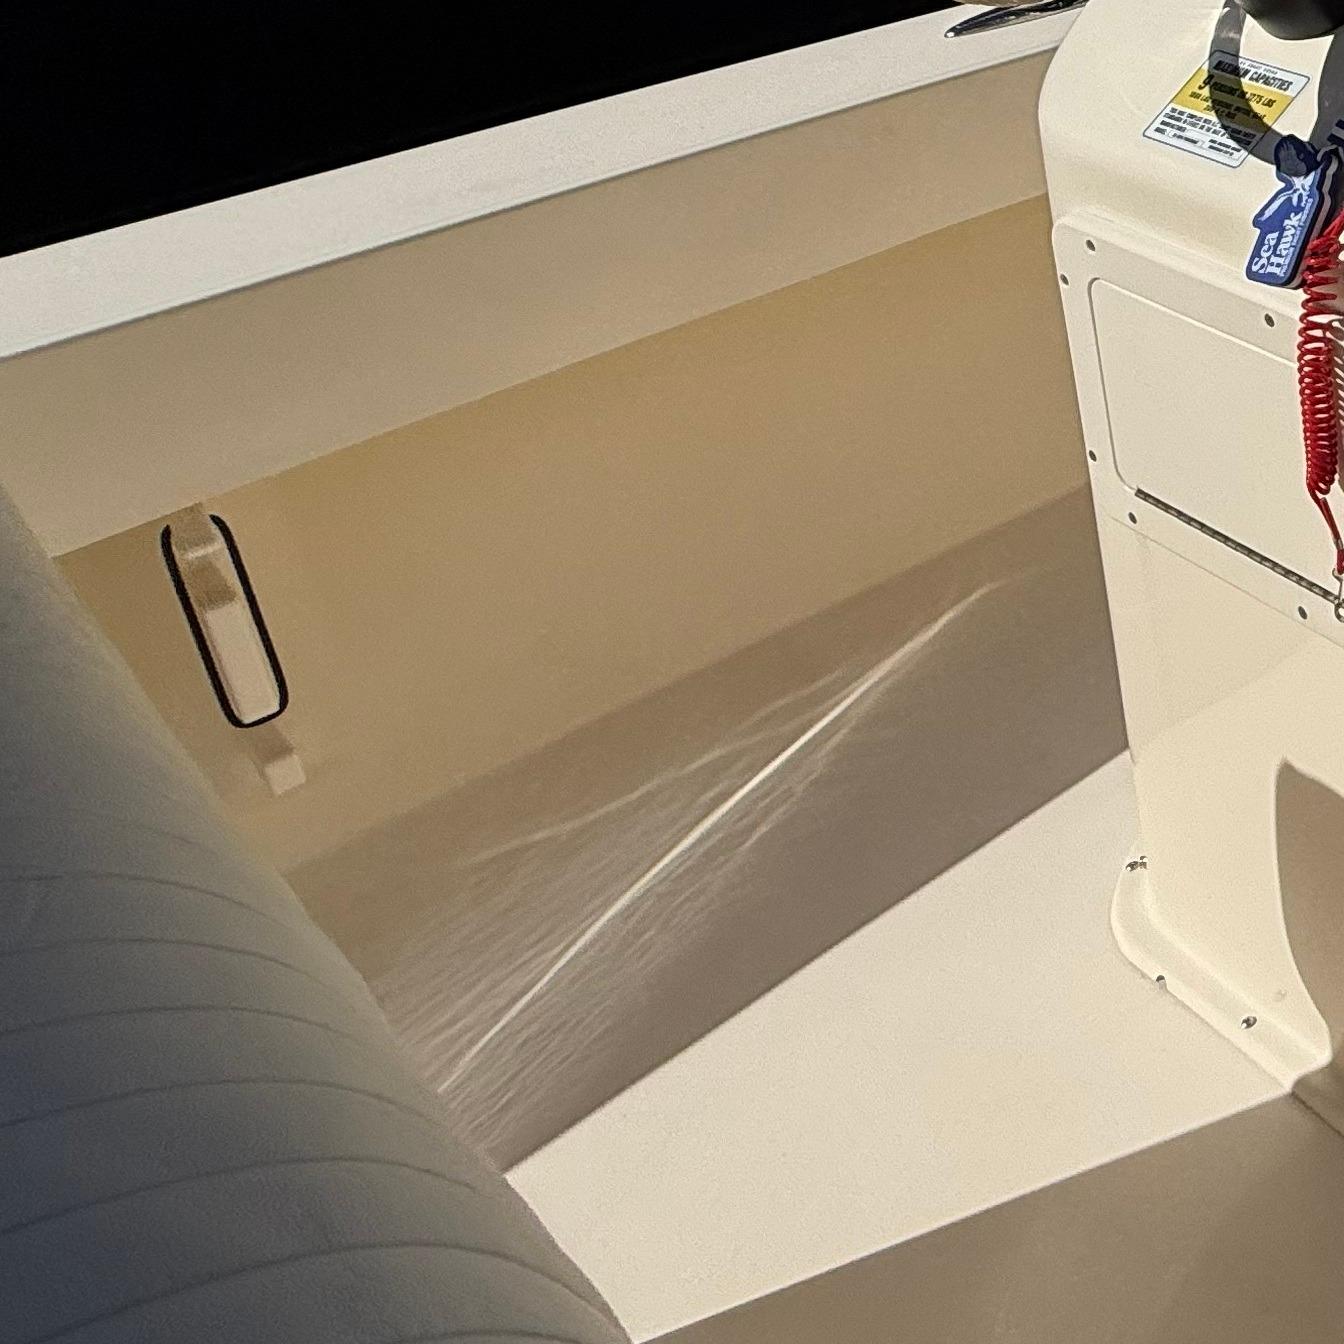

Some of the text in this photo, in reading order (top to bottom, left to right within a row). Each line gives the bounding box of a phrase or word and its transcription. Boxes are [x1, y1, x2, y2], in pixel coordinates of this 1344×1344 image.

[1249, 70, 1294, 92] CAPACITIES
[1251, 231, 1280, 274] Sea
[1265, 212, 1303, 276] Hawk
